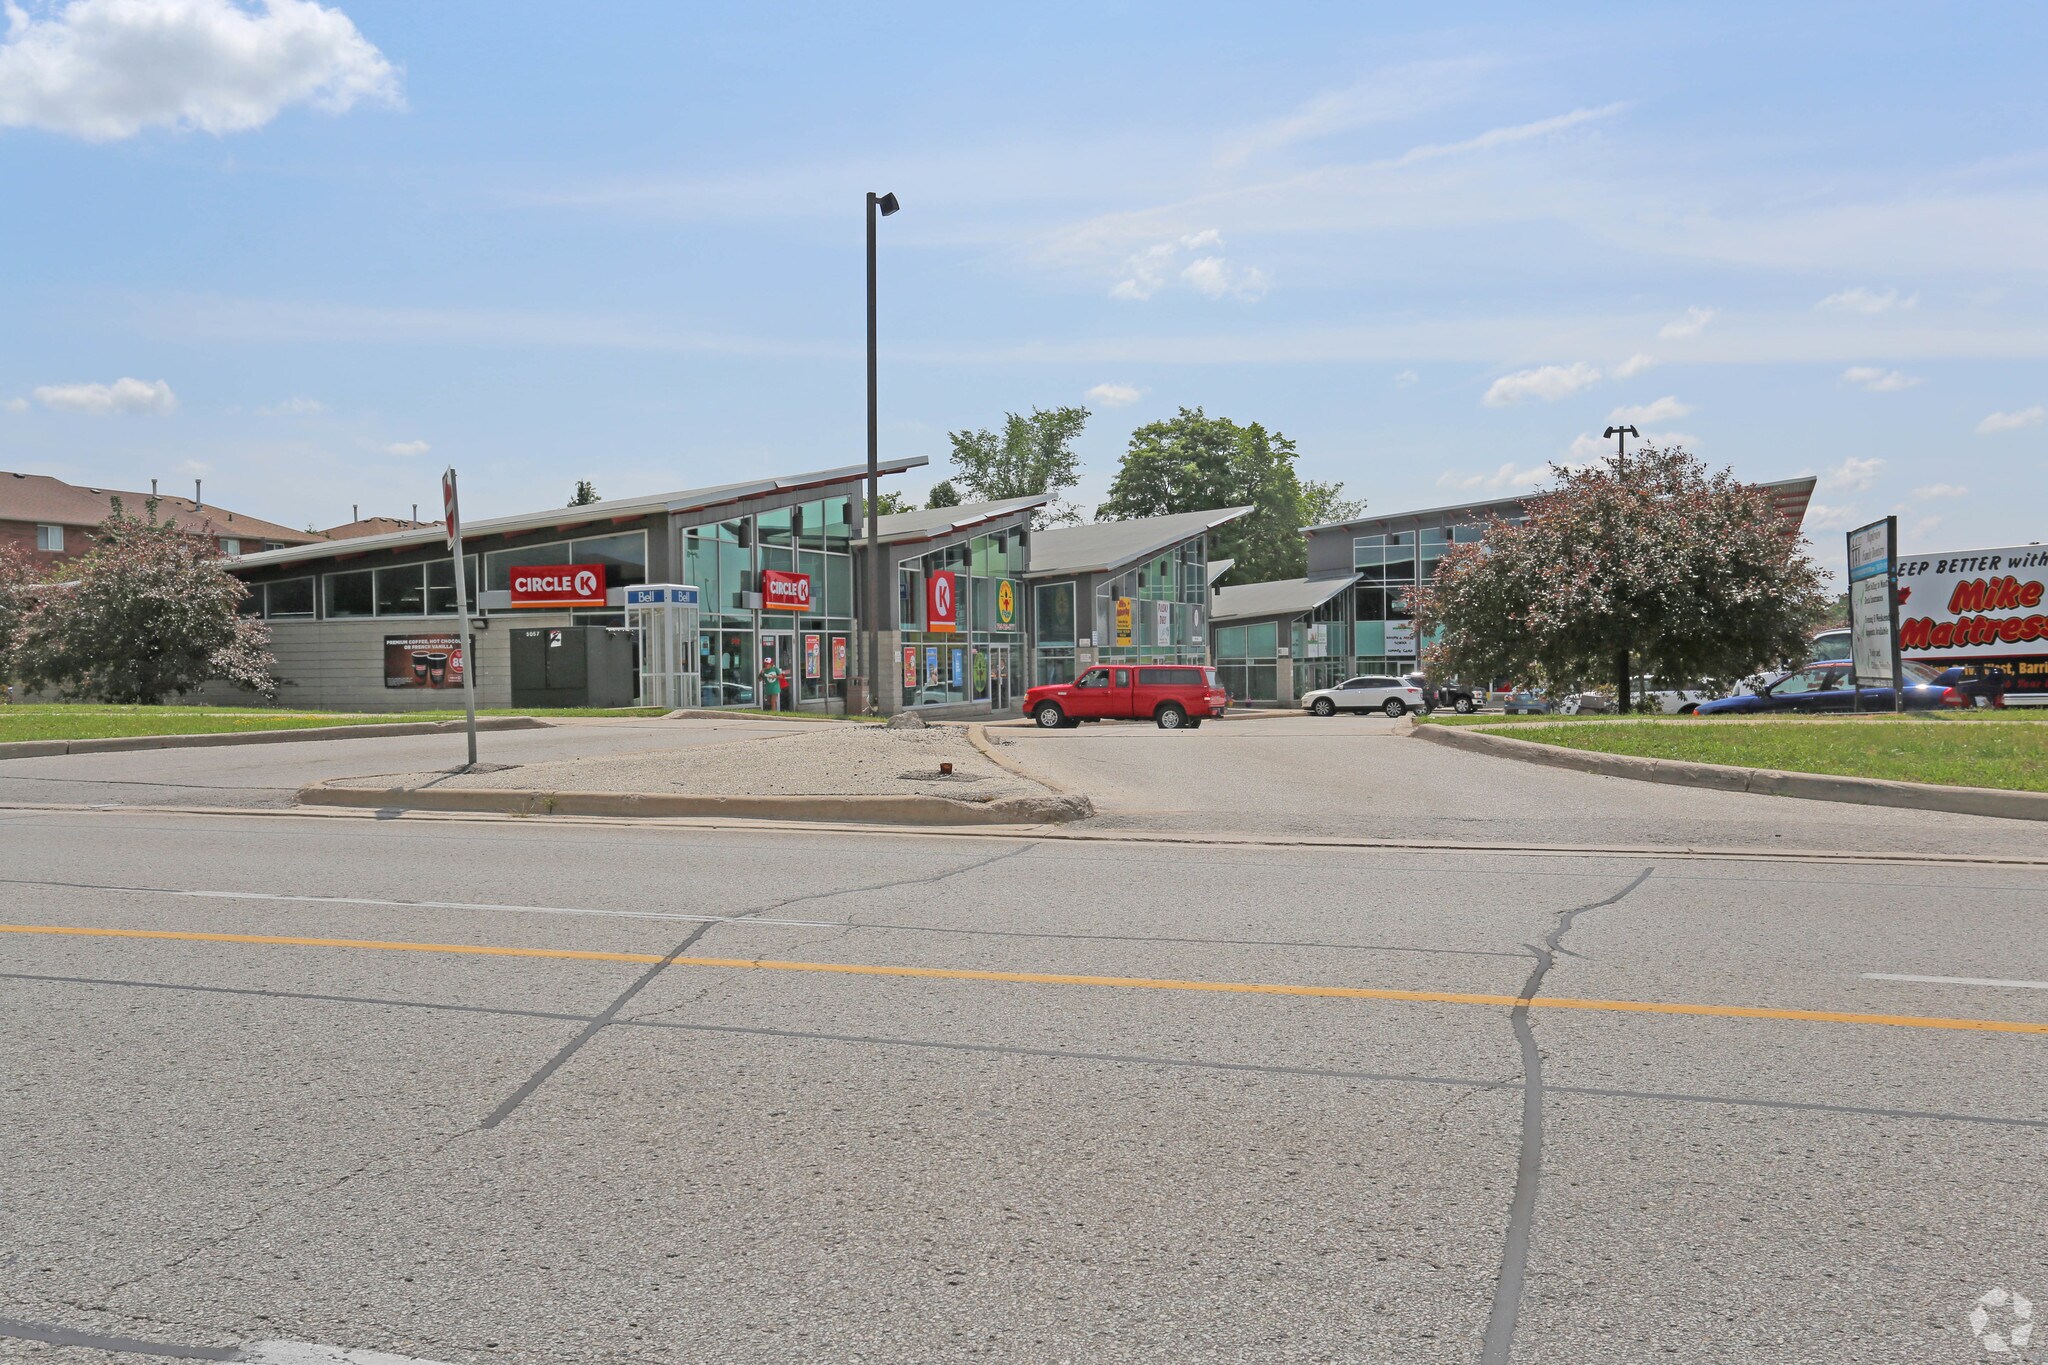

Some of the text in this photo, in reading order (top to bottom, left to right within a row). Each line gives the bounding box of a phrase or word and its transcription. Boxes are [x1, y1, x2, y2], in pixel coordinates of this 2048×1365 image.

[1935, 555, 2002, 574] BETTER
[2007, 551, 2048, 568] with
[515, 576, 572, 592] CIRCLE
[769, 580, 797, 596] CIRCLE
[638, 591, 655, 602] Bell
[678, 591, 690, 602] Bell
[1947, 575, 2045, 615] Mike
